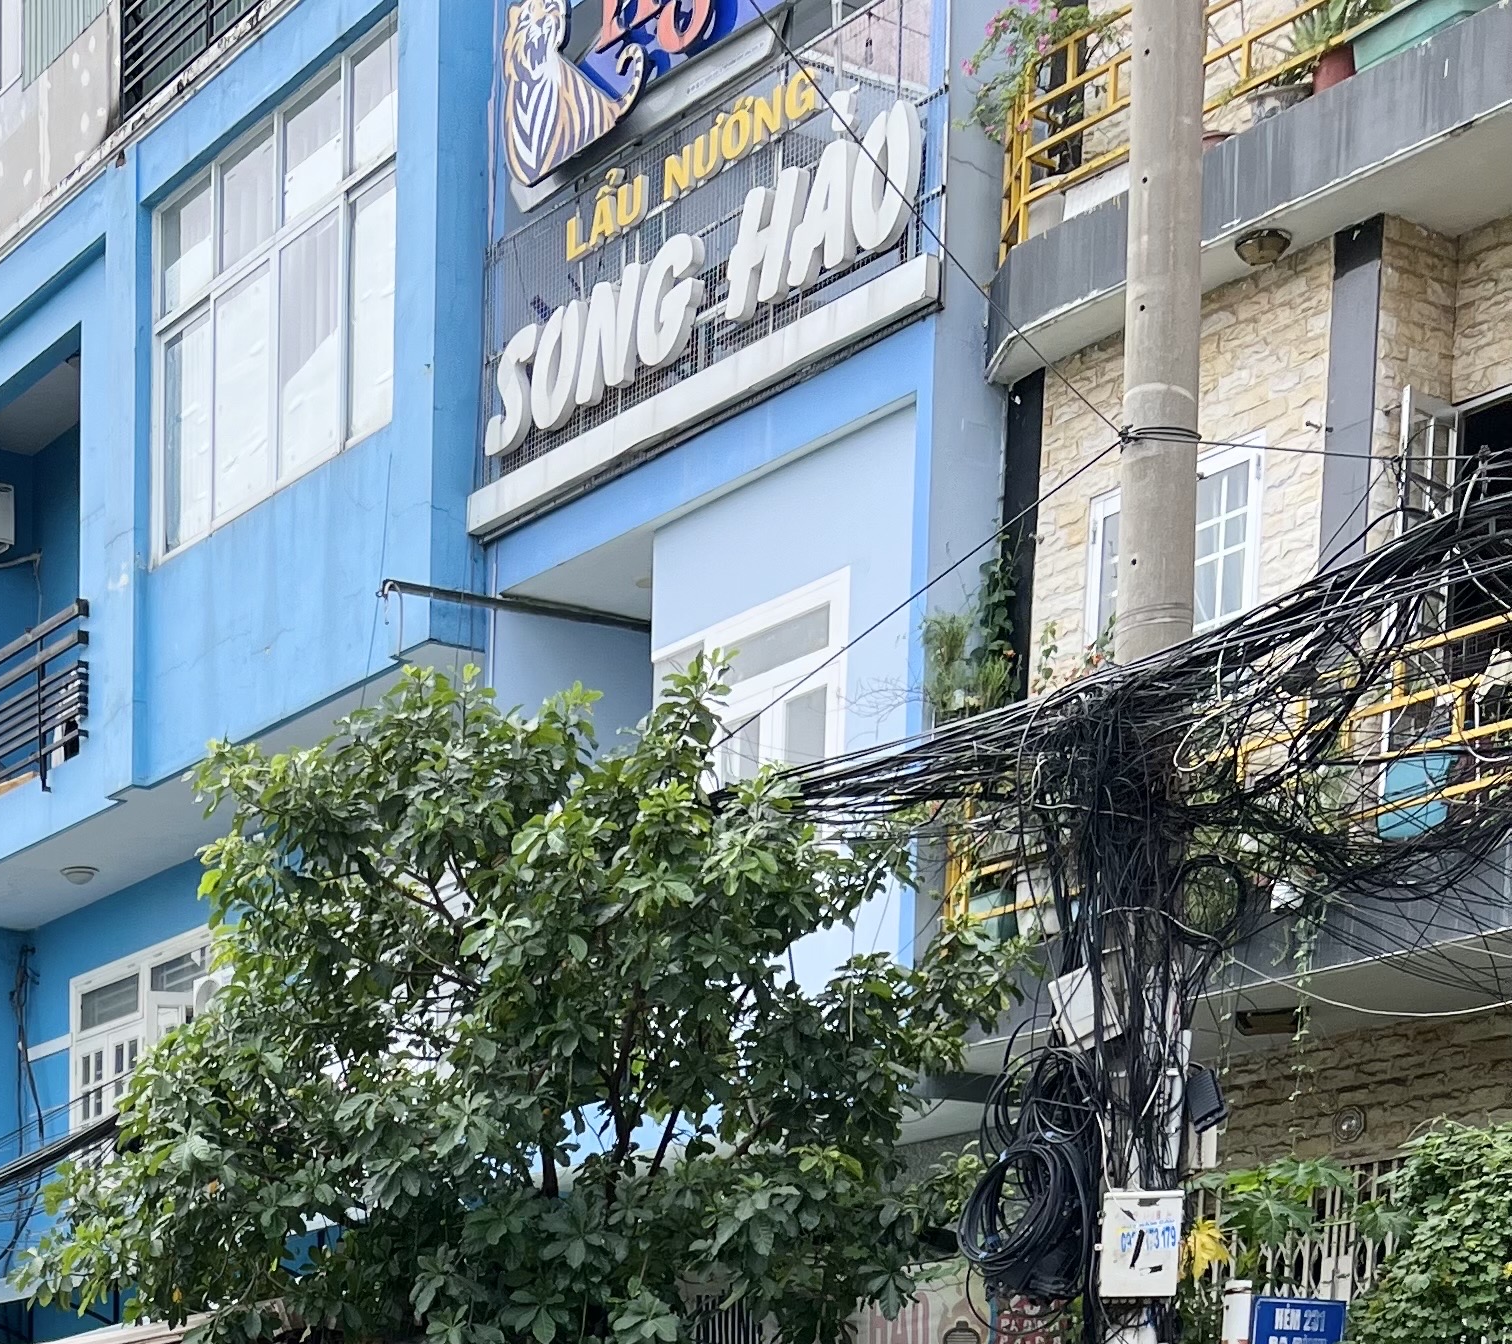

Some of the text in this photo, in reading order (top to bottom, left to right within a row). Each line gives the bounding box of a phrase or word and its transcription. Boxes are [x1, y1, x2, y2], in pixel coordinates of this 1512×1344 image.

[485, 89, 921, 457] SONG HẢO
[566, 168, 649, 262] LẨU
[664, 67, 821, 202] NƯỚNG
